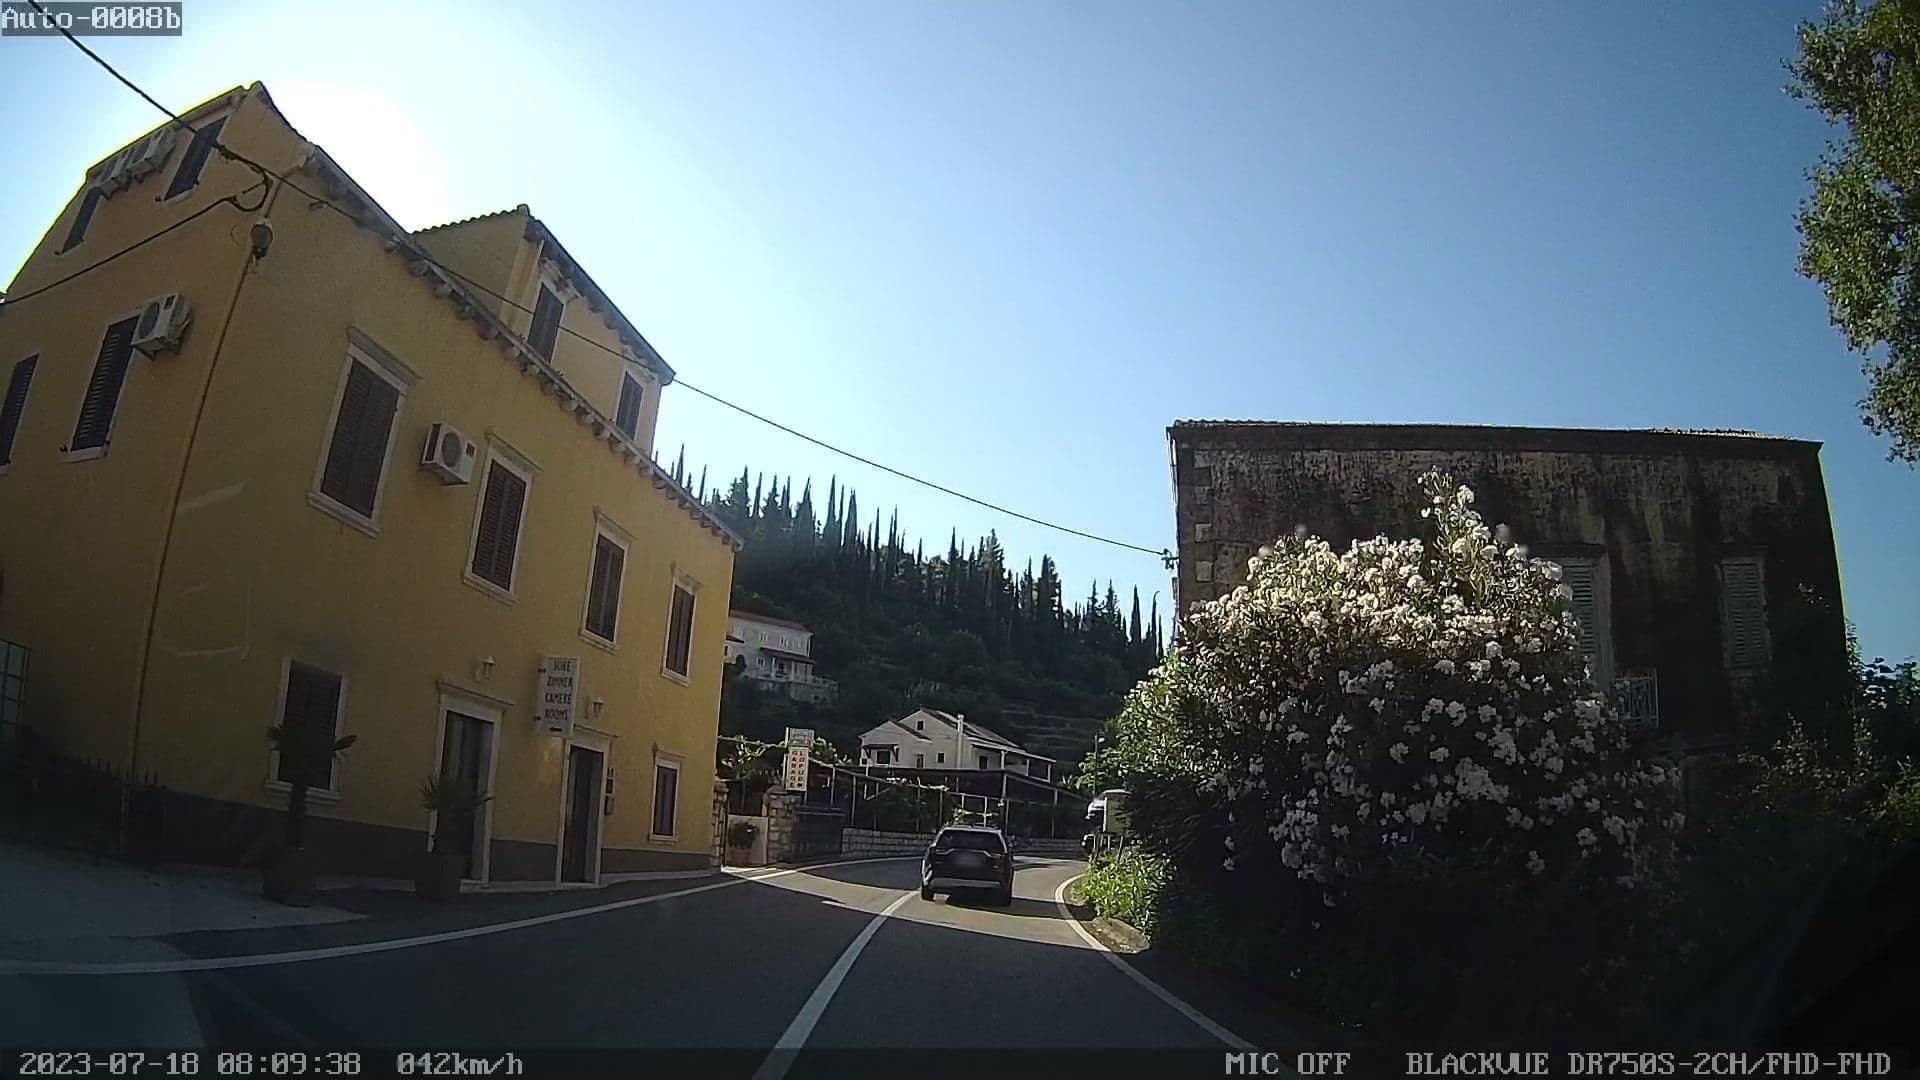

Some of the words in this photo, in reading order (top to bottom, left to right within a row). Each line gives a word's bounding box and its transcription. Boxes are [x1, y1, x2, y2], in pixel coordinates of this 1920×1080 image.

[547, 675, 573, 688] ZIMMER
[545, 692, 572, 704] CAMERE
[545, 708, 568, 720] ROOMS
[790, 751, 798, 788] GARAGE
